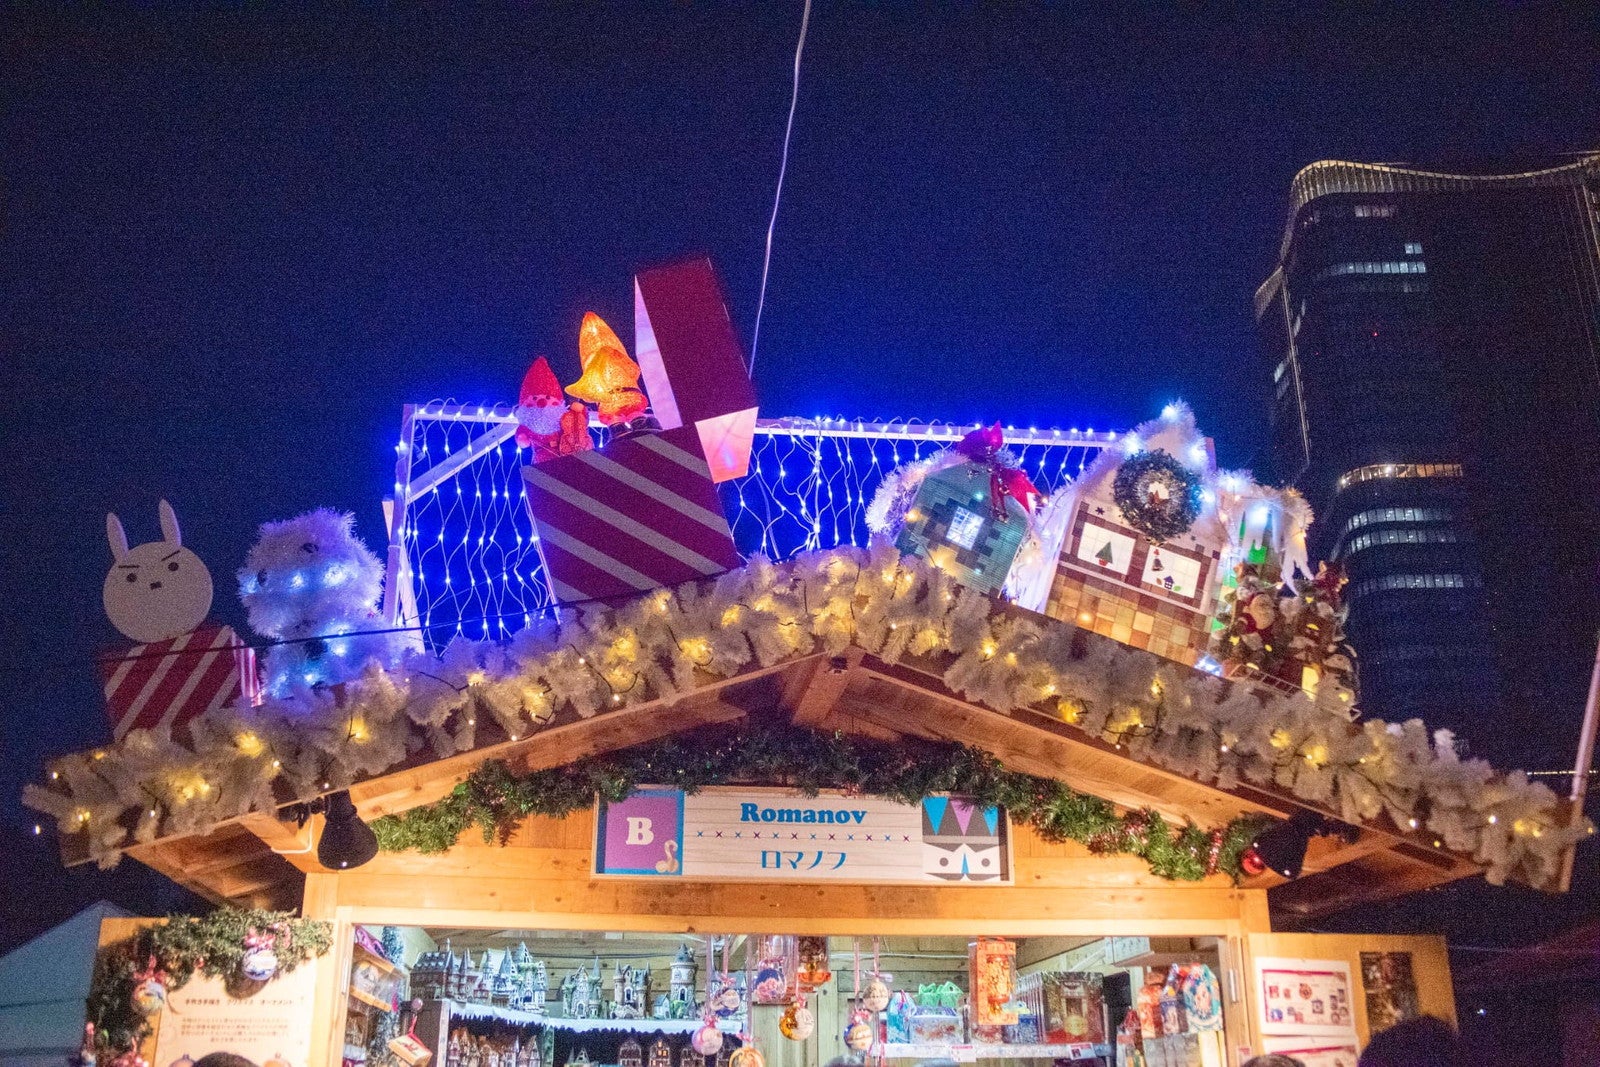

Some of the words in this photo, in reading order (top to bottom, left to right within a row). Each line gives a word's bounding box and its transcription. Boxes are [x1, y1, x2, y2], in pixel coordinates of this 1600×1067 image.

[740, 802, 867, 824] Romanov
[626, 817, 654, 845] B
[761, 850, 847, 870] ロマノフ
